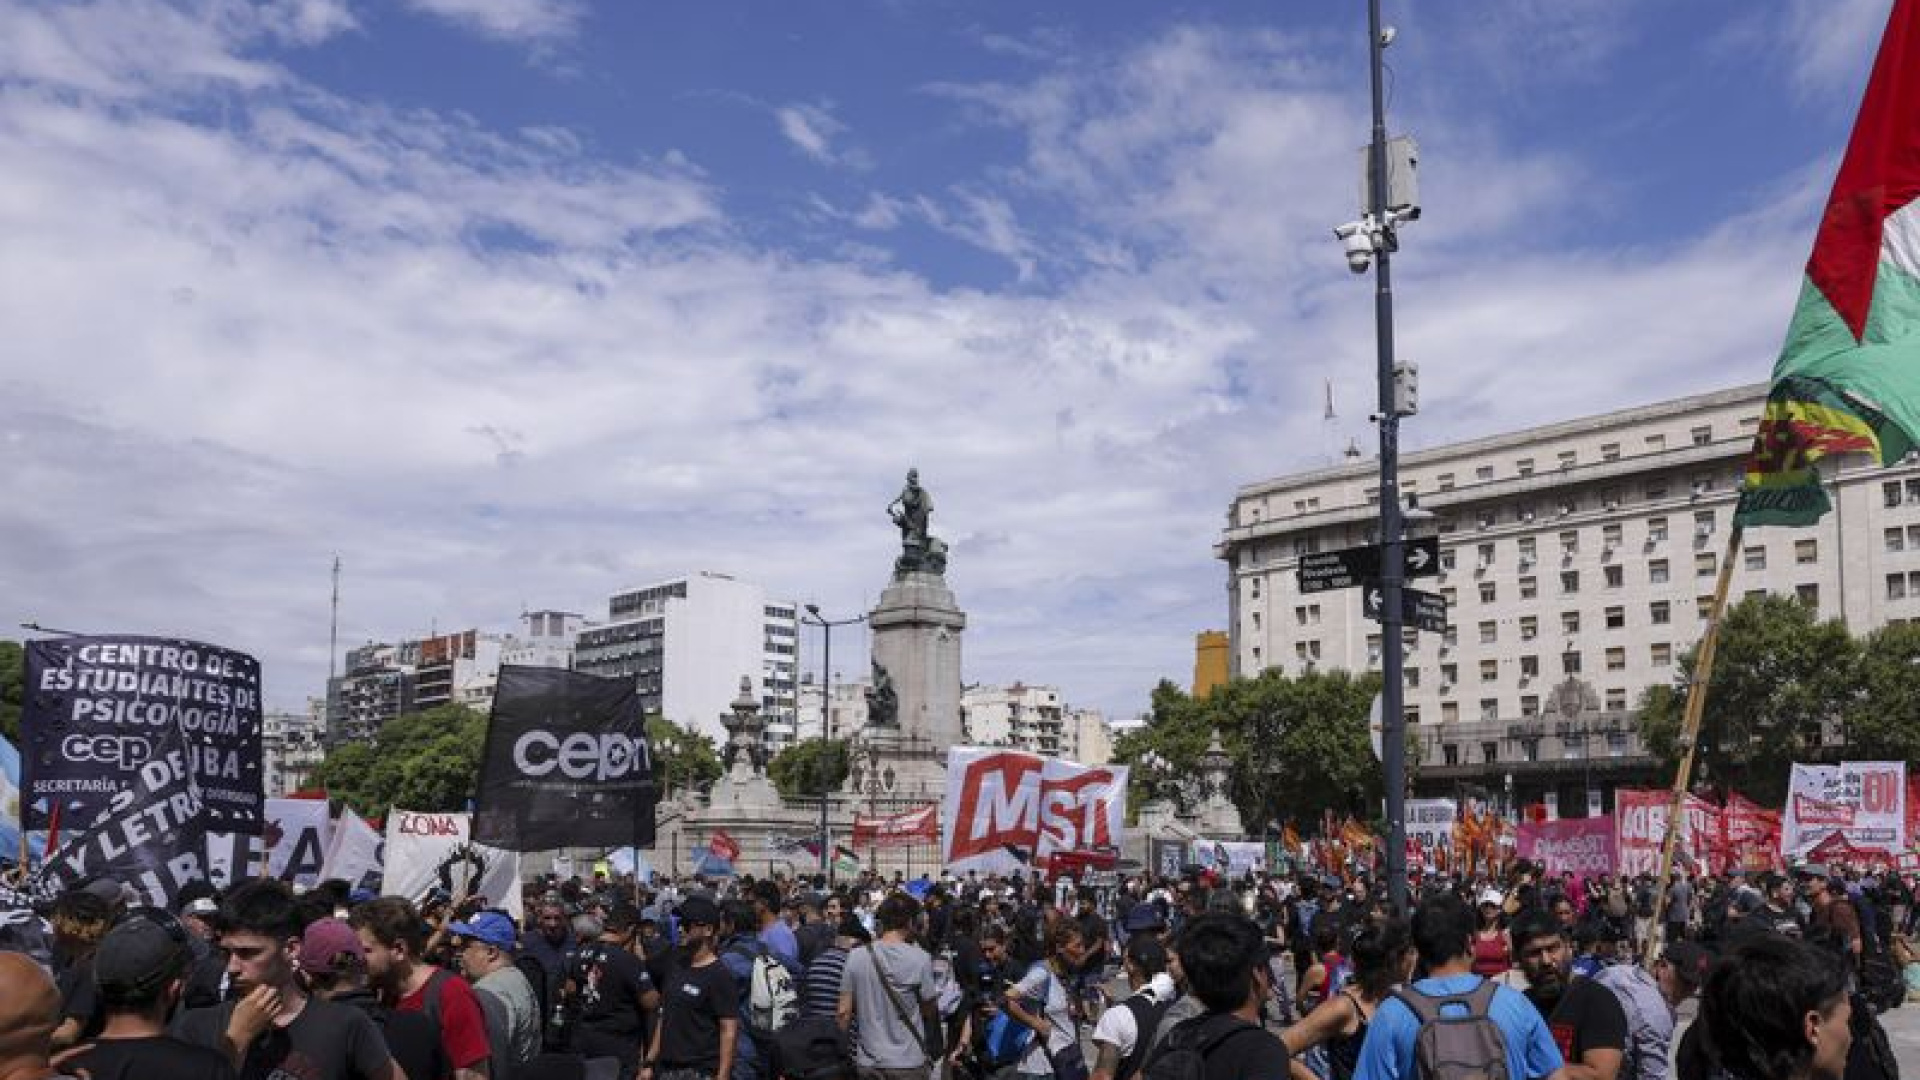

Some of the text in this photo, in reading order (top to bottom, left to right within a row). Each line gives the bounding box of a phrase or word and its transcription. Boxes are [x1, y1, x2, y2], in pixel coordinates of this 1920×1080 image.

[78, 644, 234, 678] CENTRO DE
[40, 668, 257, 711] ESTUDIANTES DE
[71, 697, 239, 736] PSICOOGÍA
[61, 733, 153, 771] cep
[33, 777, 118, 793] SECRETARÍA
[140, 751, 187, 792] DE
[399, 813, 459, 837] ZONA
[969, 768, 1116, 852] MST
